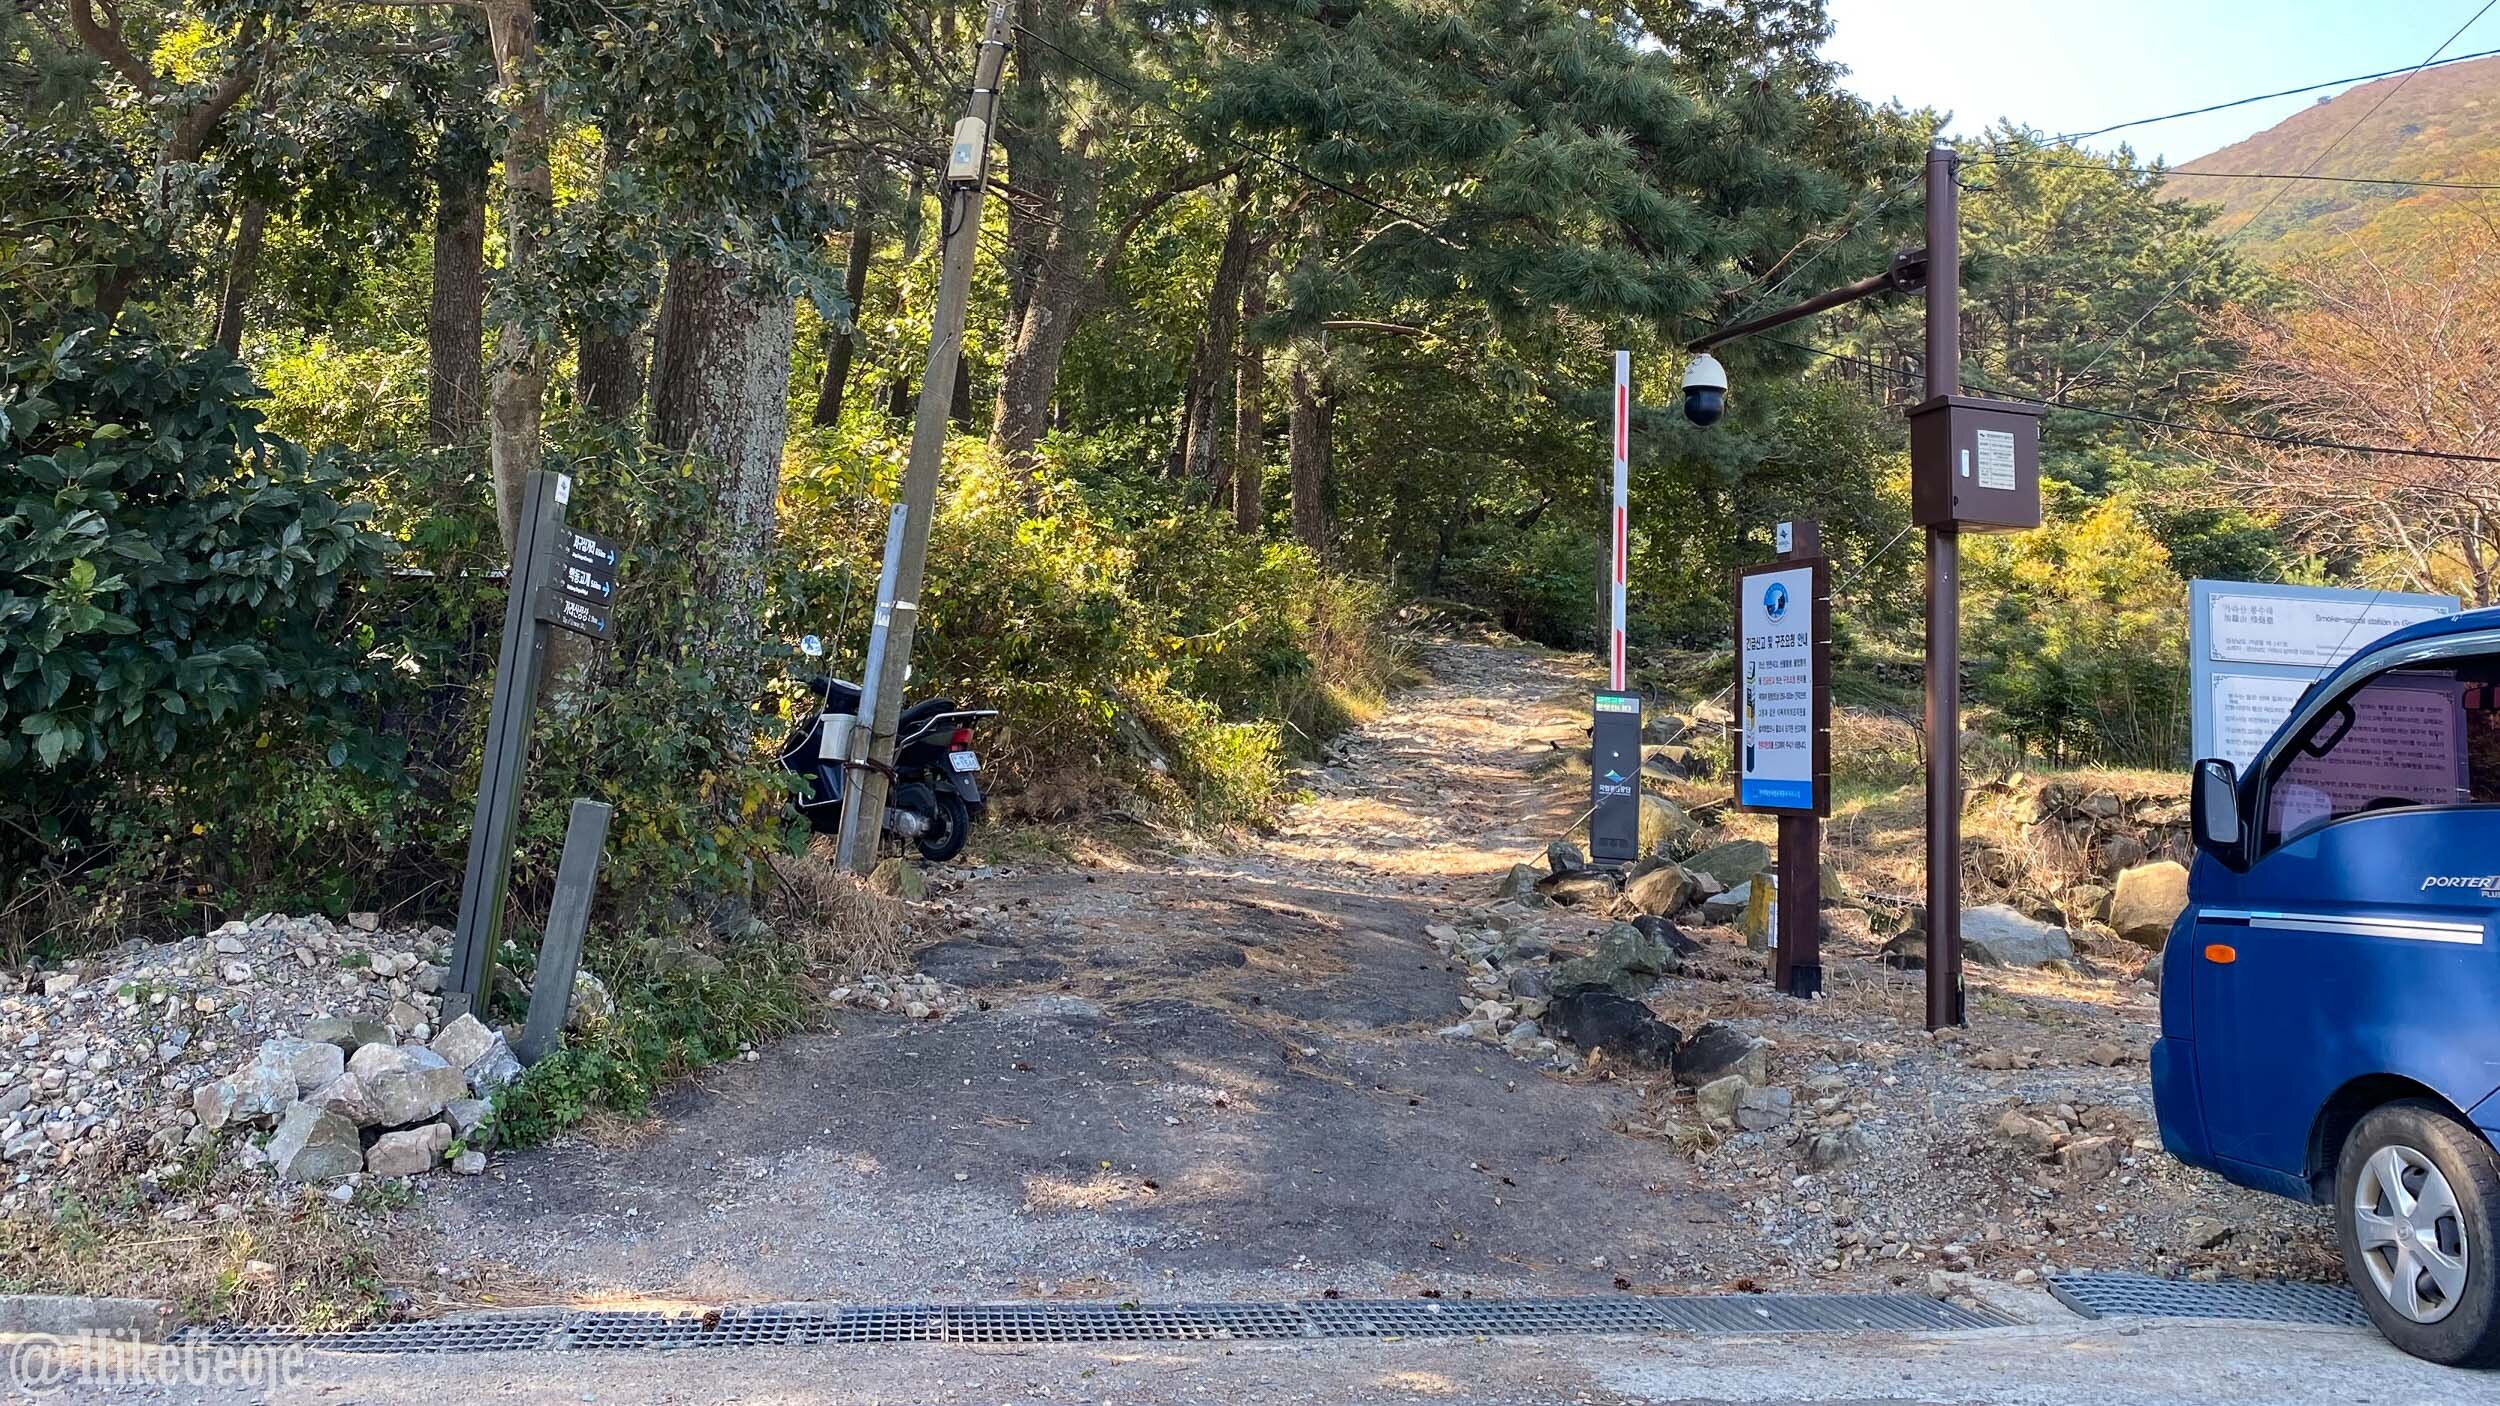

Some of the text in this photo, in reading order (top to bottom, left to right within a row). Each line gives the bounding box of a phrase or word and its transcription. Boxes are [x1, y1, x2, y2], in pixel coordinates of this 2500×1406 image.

[1746, 632, 1808, 651] 긴급신고 및 구조요청 안내
[2420, 876, 2492, 891] PORTER
